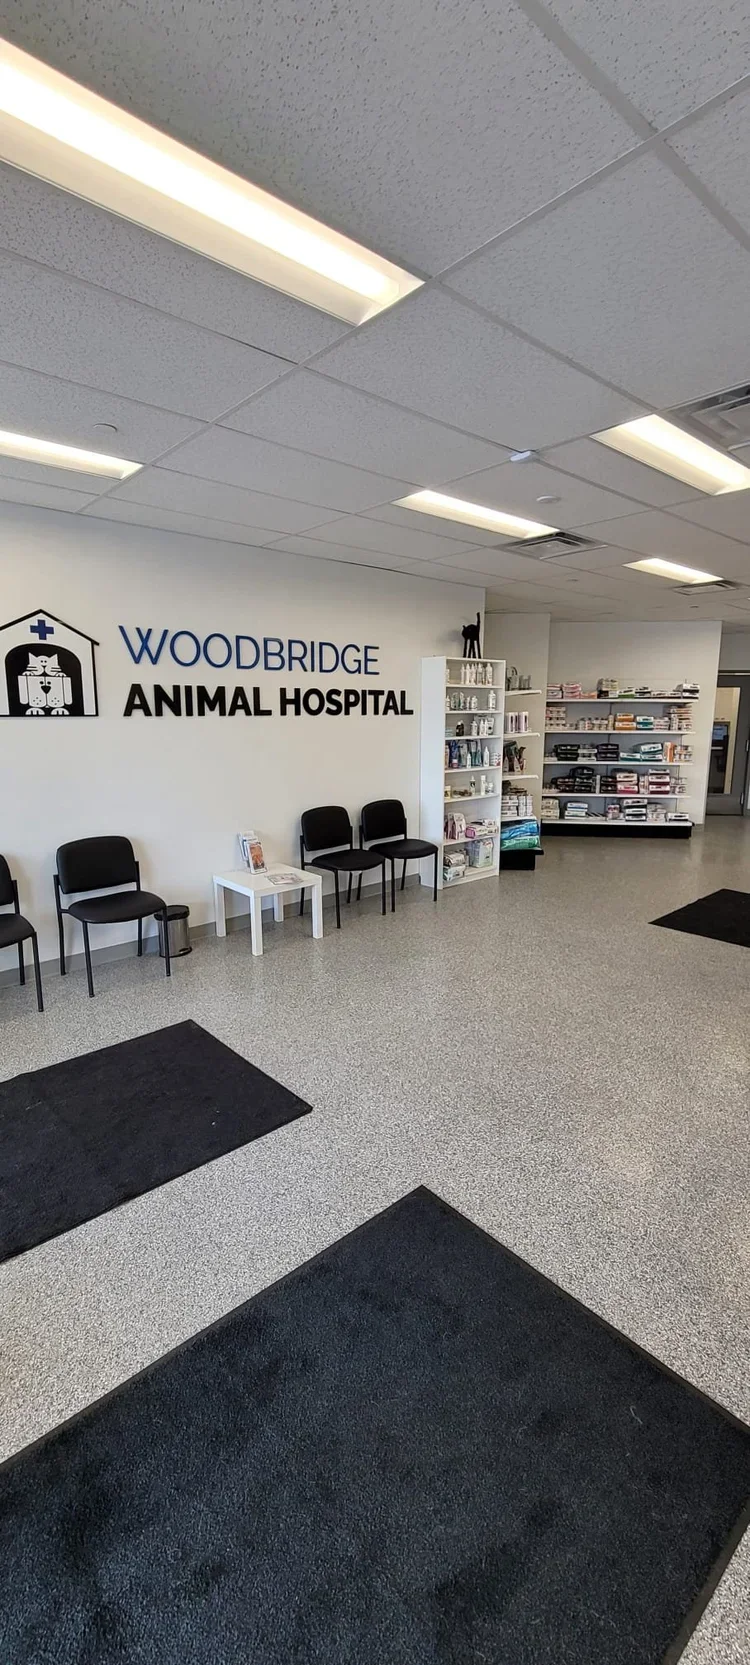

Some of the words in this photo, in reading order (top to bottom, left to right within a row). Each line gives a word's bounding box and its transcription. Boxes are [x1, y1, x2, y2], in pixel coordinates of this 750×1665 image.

[119, 625, 380, 675] WOODBRIDGE
[123, 683, 272, 717] ANIMAL
[280, 687, 414, 716] HOSPITAL
